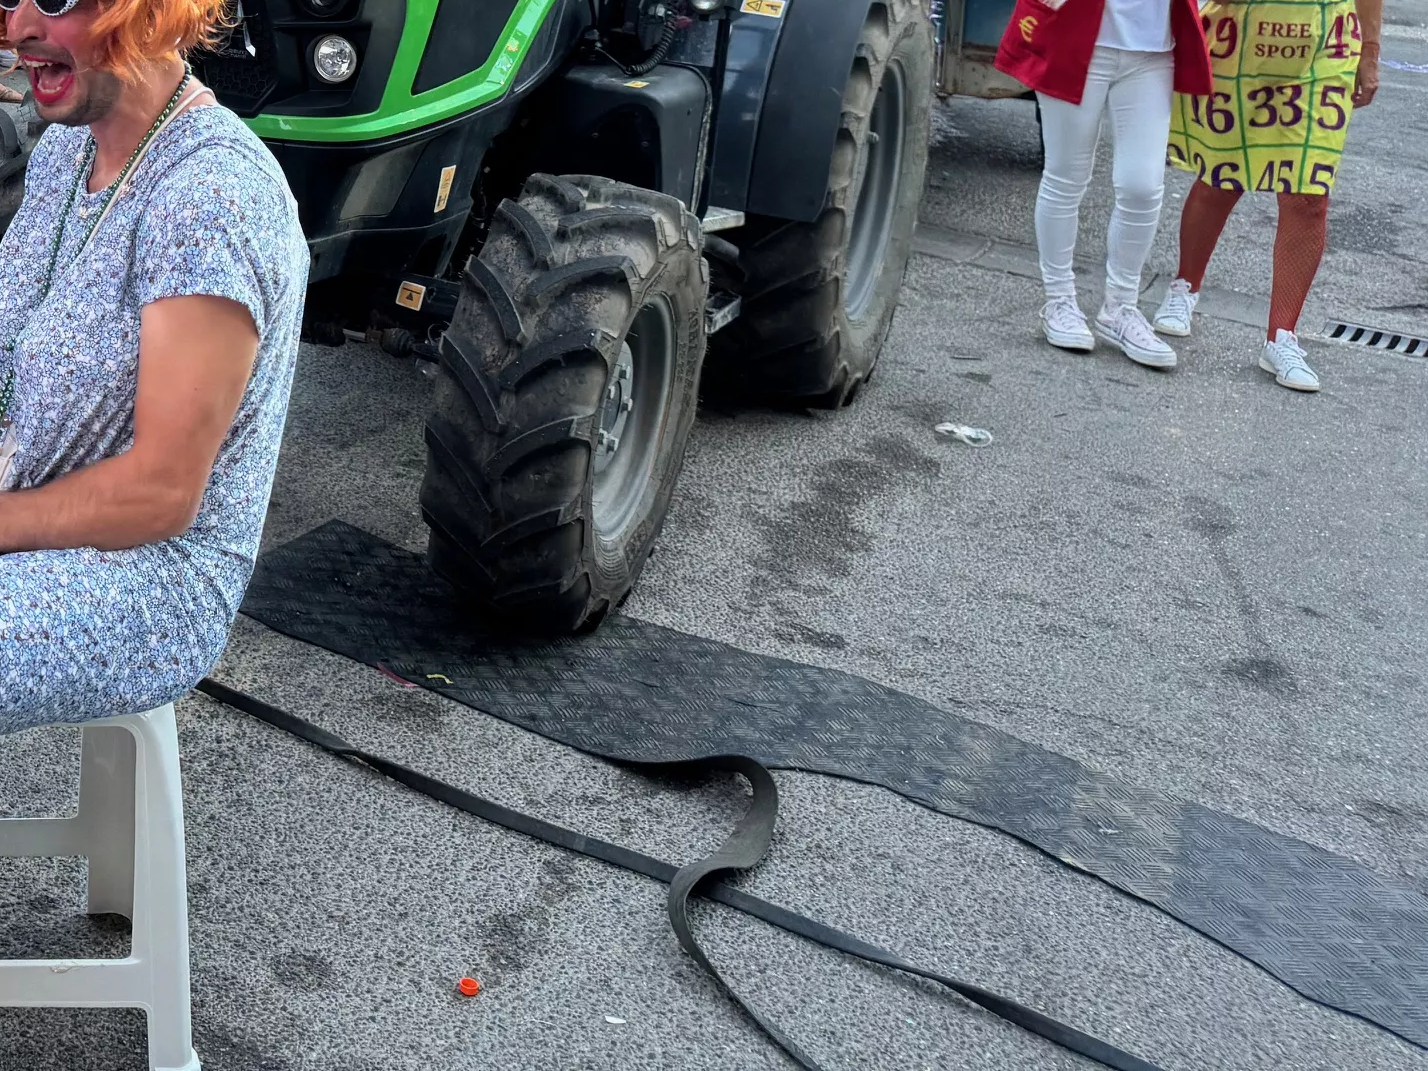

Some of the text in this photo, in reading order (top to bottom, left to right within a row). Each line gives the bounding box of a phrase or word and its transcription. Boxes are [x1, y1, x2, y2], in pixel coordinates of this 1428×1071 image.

[1256, 21, 1312, 39] FREE
[1254, 43, 1311, 59] SPOT
[1247, 84, 1304, 129] 33
